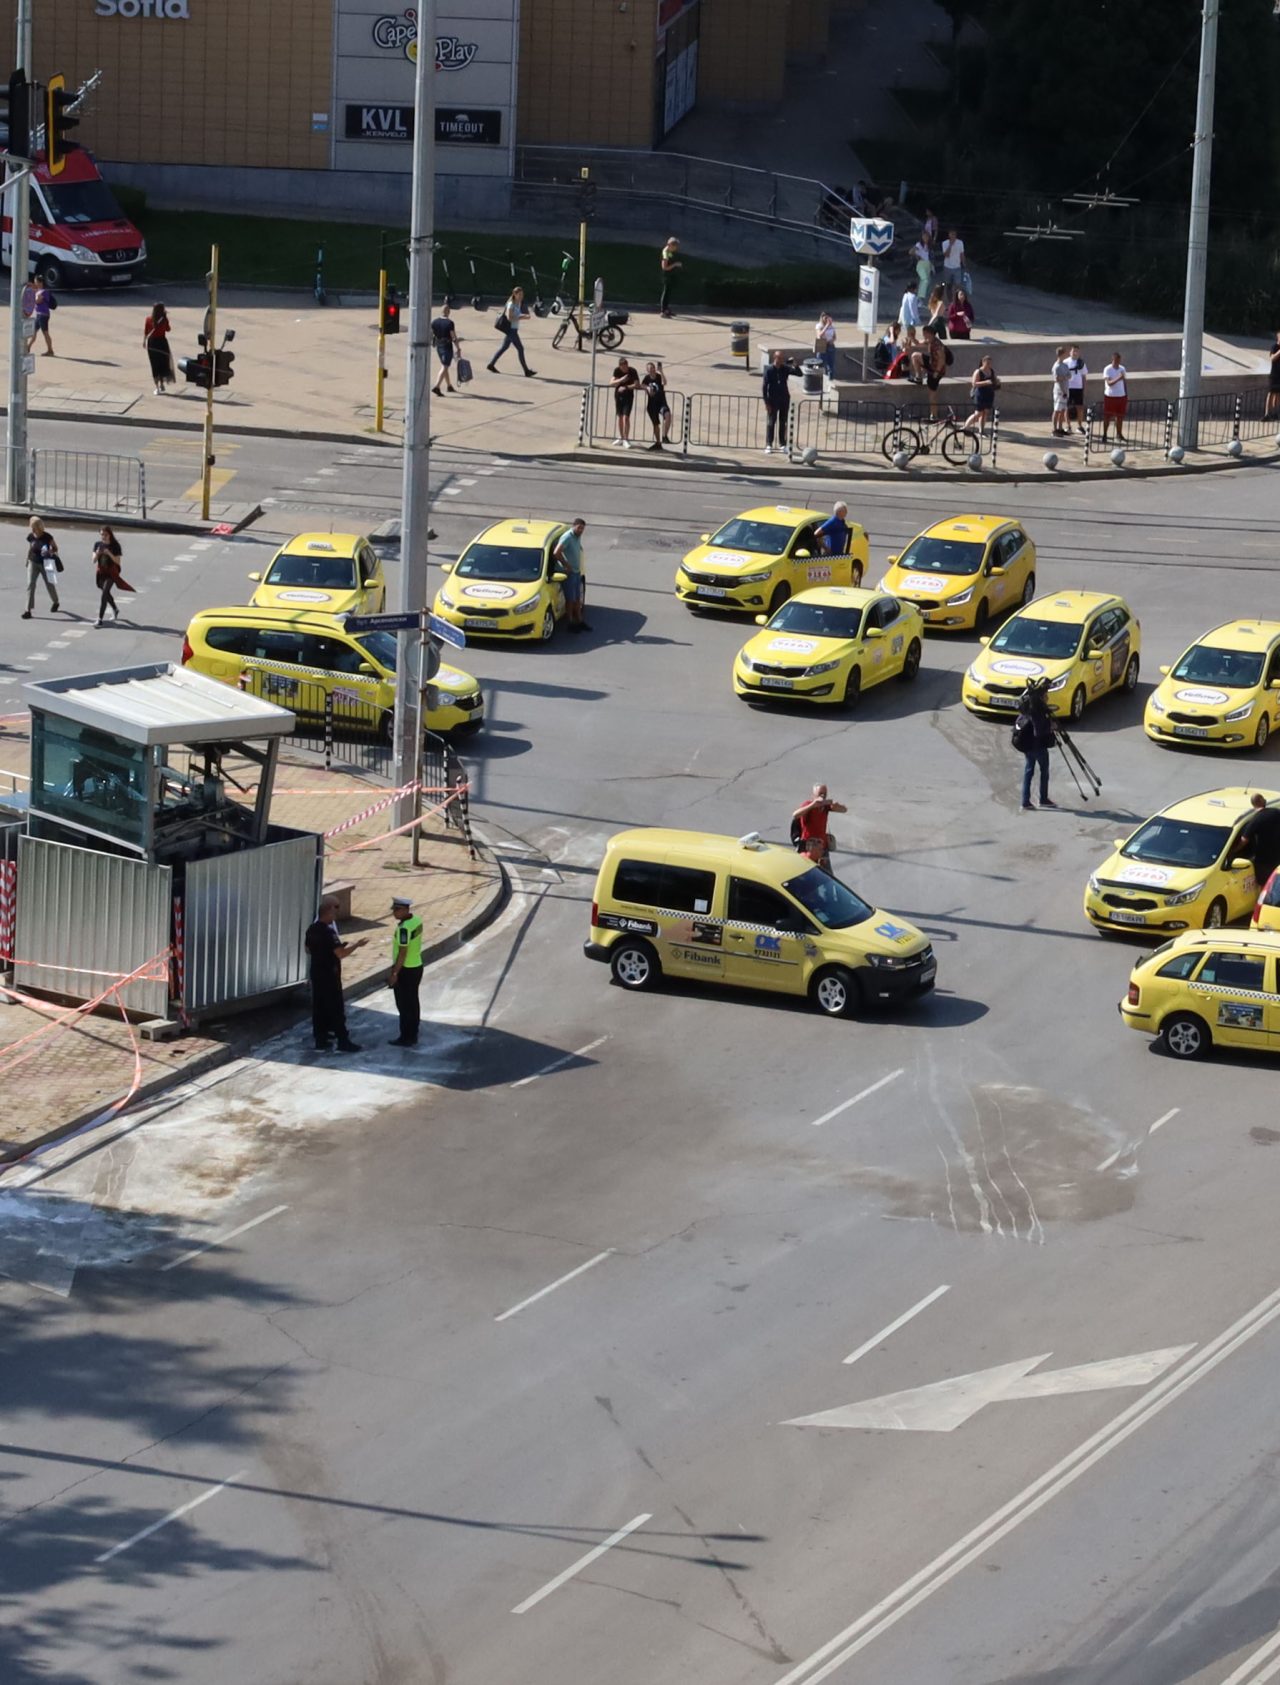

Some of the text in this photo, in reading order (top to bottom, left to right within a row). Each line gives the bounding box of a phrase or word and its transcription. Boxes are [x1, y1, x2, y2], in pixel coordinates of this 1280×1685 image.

[374, 18, 417, 47] Cape
[436, 39, 477, 61] Play
[362, 108, 407, 130] KVL
[440, 121, 484, 133] TIMEOUT
[627, 920, 653, 933] Fibank
[755, 934, 781, 950] OK
[683, 950, 721, 964] Fibank
